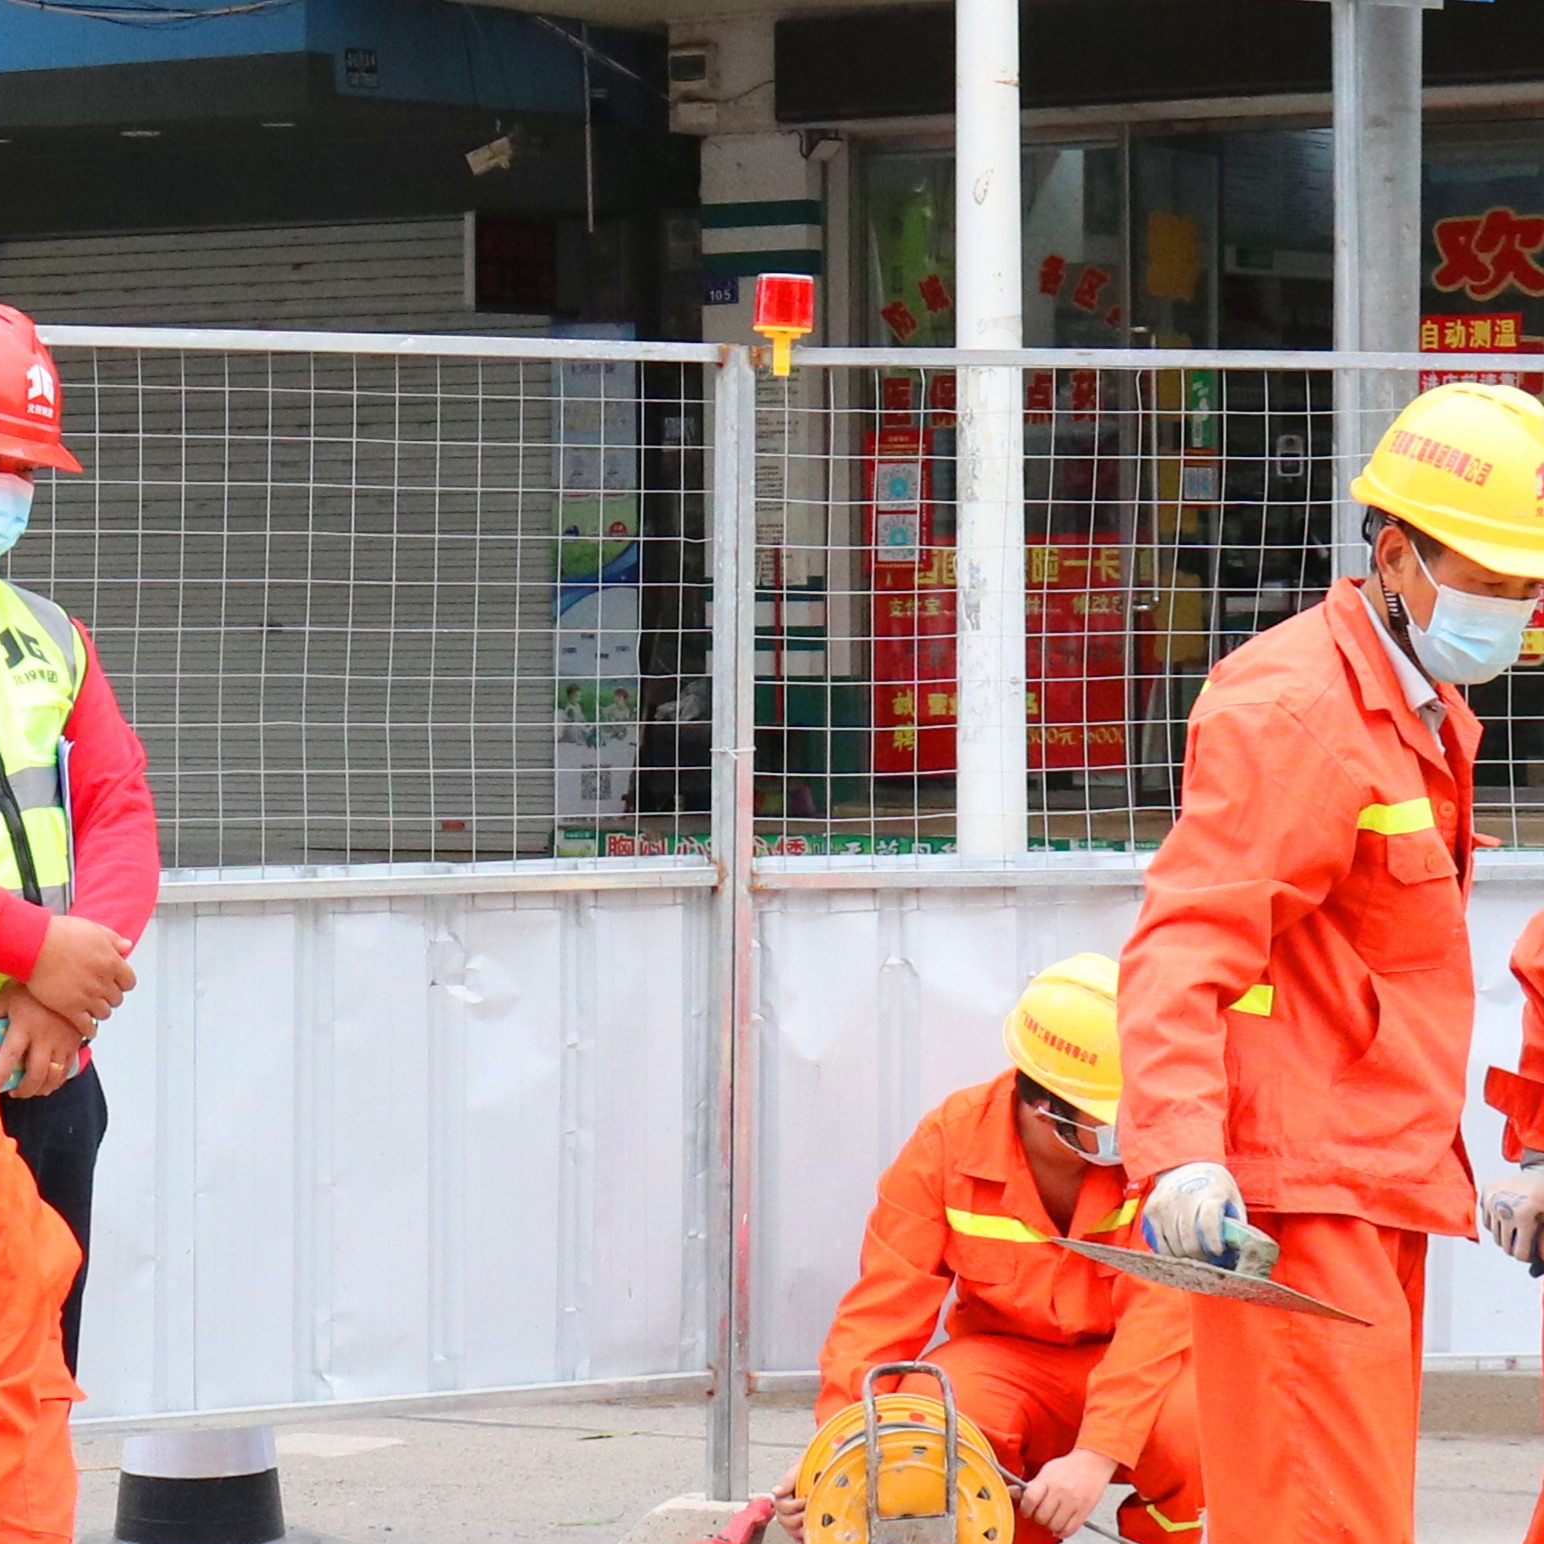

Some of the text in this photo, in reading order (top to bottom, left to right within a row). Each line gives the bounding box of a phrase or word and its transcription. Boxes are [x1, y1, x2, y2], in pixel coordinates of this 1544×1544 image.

[709, 290, 732, 301] 105
[1421, 319, 1517, 350] 自动测温
